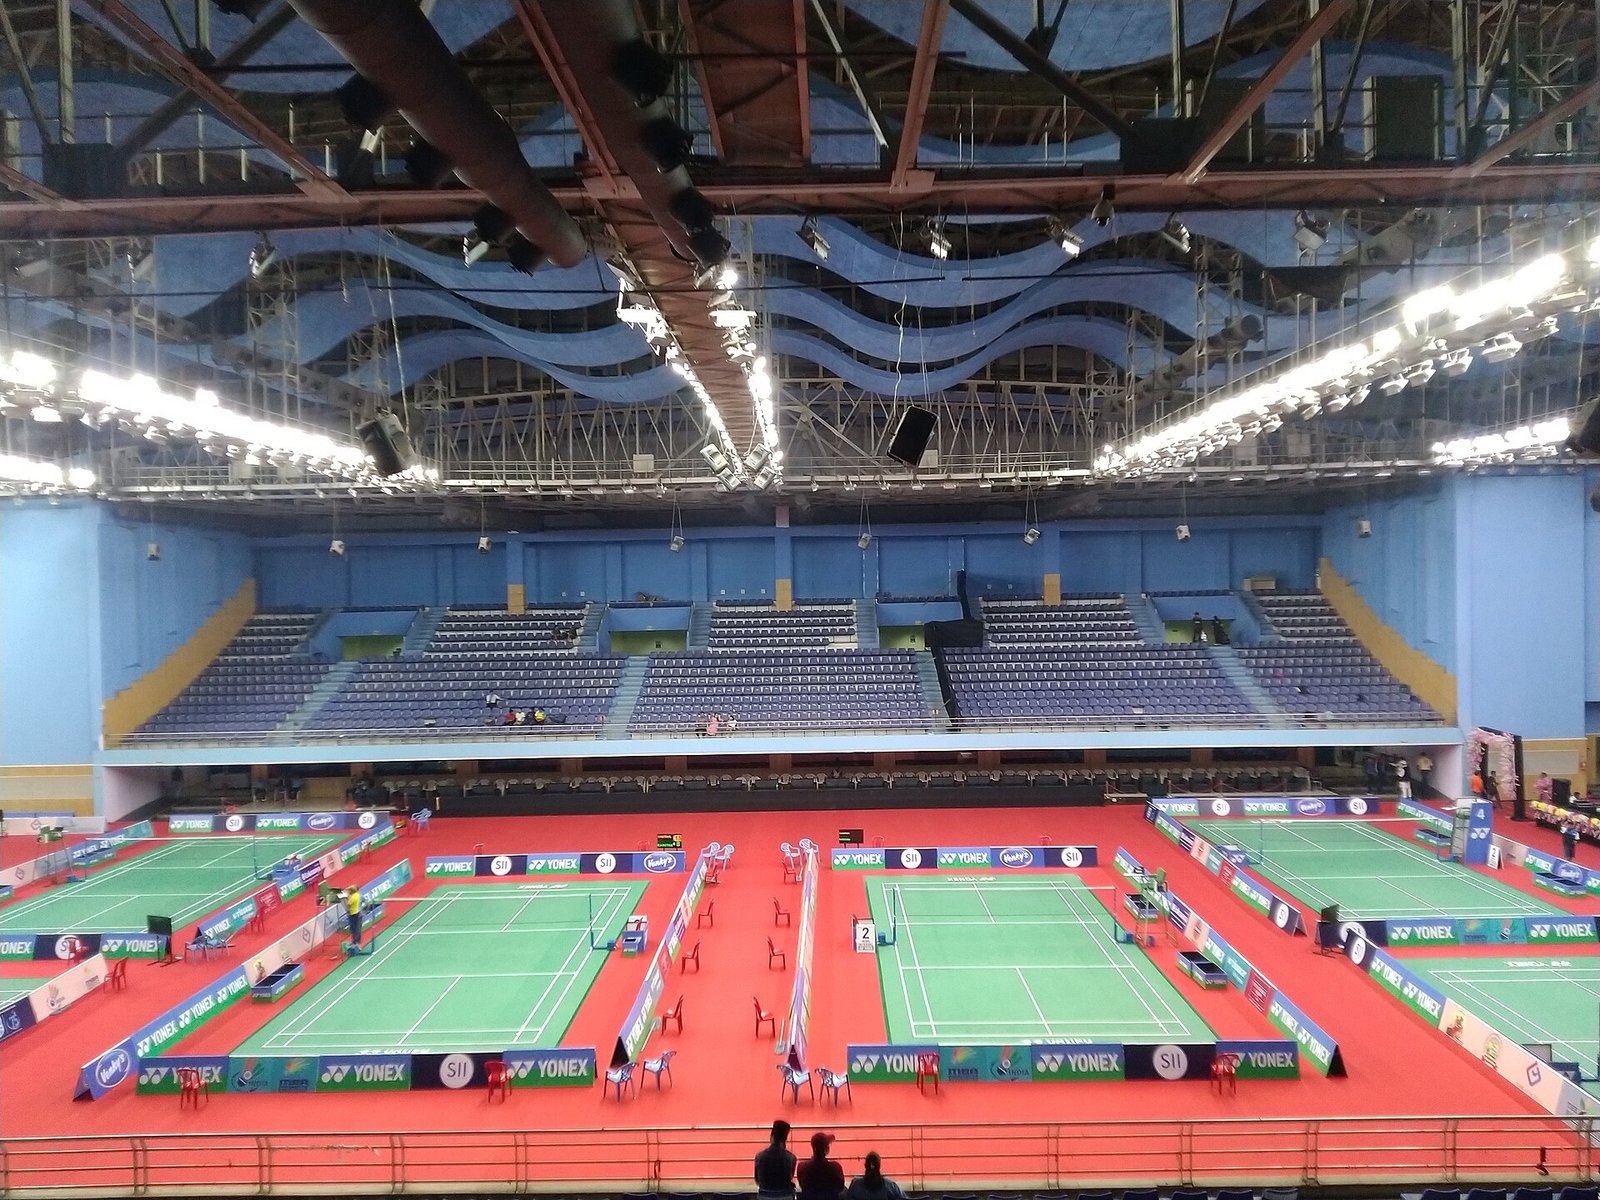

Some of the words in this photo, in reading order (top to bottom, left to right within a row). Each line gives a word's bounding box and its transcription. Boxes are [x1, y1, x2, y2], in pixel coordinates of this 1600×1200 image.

[1171, 804, 1197, 812] YONEX
[1262, 803, 1288, 811] YONEX
[1476, 809, 1485, 820] 4
[186, 820, 210, 829] YONEX
[273, 819, 297, 827] YONEX
[852, 854, 883, 864] YONEX
[905, 853, 917, 862] SII
[958, 853, 989, 863] YONEX
[1066, 852, 1078, 861] SII
[444, 861, 472, 872] YONEX
[495, 860, 507, 869] SII
[547, 858, 577, 869] YONEX
[600, 858, 612, 867] SII
[862, 928, 870, 939] 2
[1414, 926, 1455, 939] YONEX
[1553, 924, 1594, 937] YONEX
[0, 942, 32, 954] ONEX
[1383, 963, 1403, 990] YONEX
[1417, 989, 1441, 1019] YONEX
[150, 1020, 178, 1047] YONEX
[190, 995, 215, 1019] YONEX
[227, 974, 248, 996] YONEX
[1309, 1036, 1331, 1066] YONEX
[1067, 1053, 1120, 1072] YONEX
[1161, 1053, 1181, 1069] SII
[1249, 1052, 1294, 1068] YONEX
[100, 1053, 125, 1083] Venky's
[354, 1064, 405, 1082] YONEX
[447, 1061, 467, 1078] SII
[538, 1058, 590, 1078] YONEX
